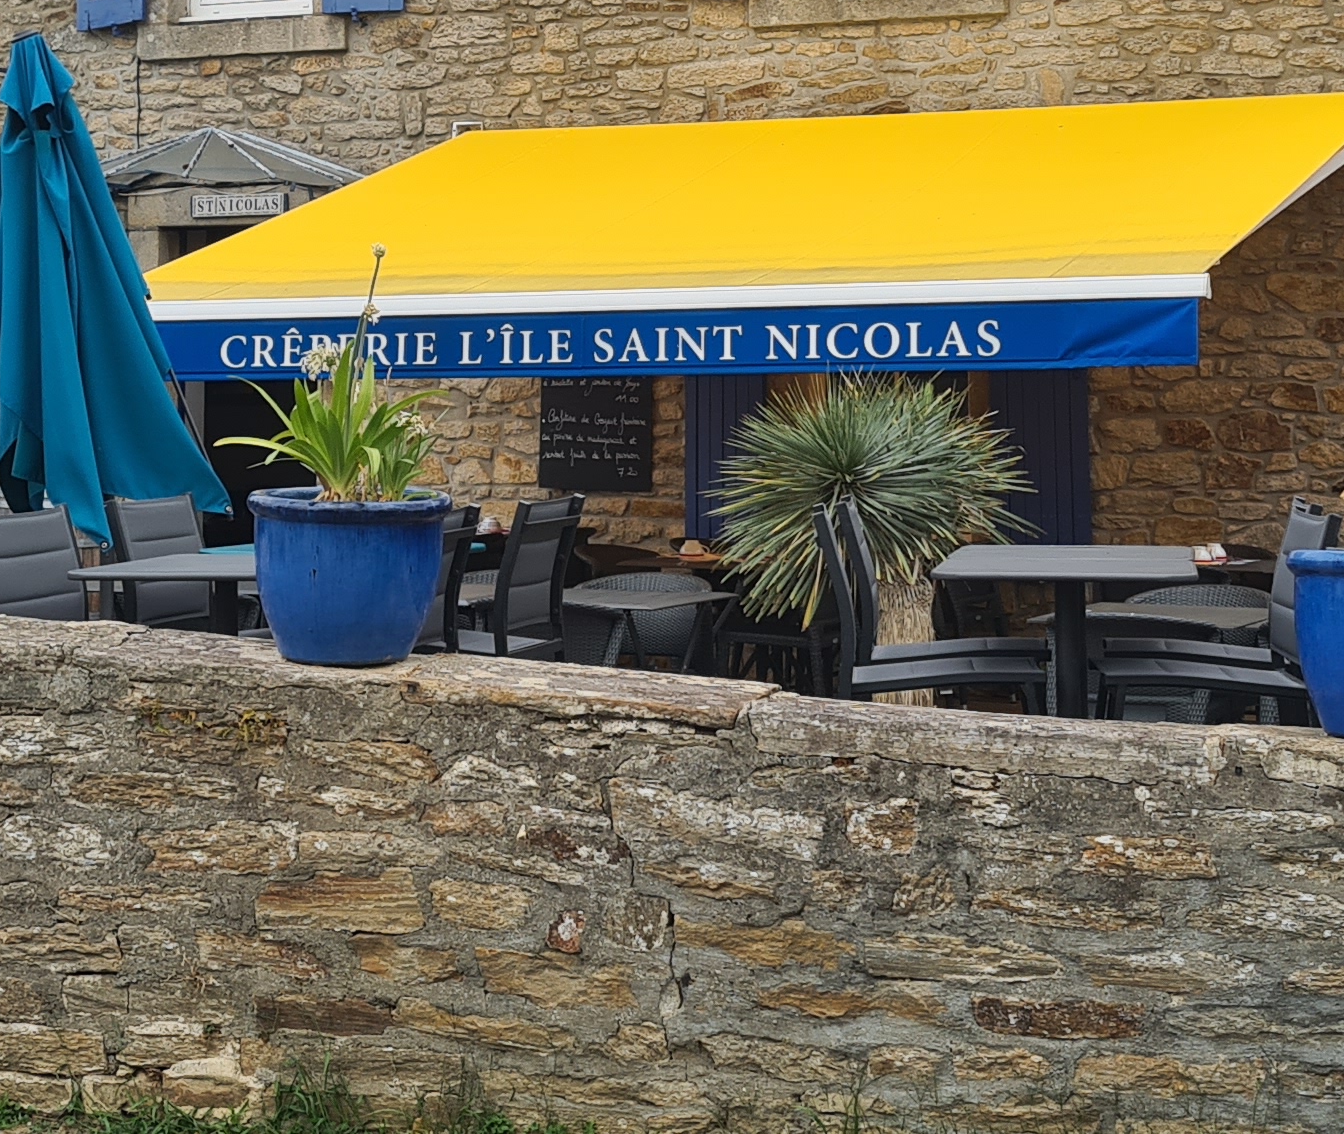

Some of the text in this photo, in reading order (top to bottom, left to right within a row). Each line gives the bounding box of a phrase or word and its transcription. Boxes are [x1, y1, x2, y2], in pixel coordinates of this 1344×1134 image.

[197, 197, 280, 214] ST NICOLAS
[458, 323, 573, 365] L'ÎLE
[593, 324, 742, 363] SAINT
[765, 319, 1002, 360] NICOLAS
